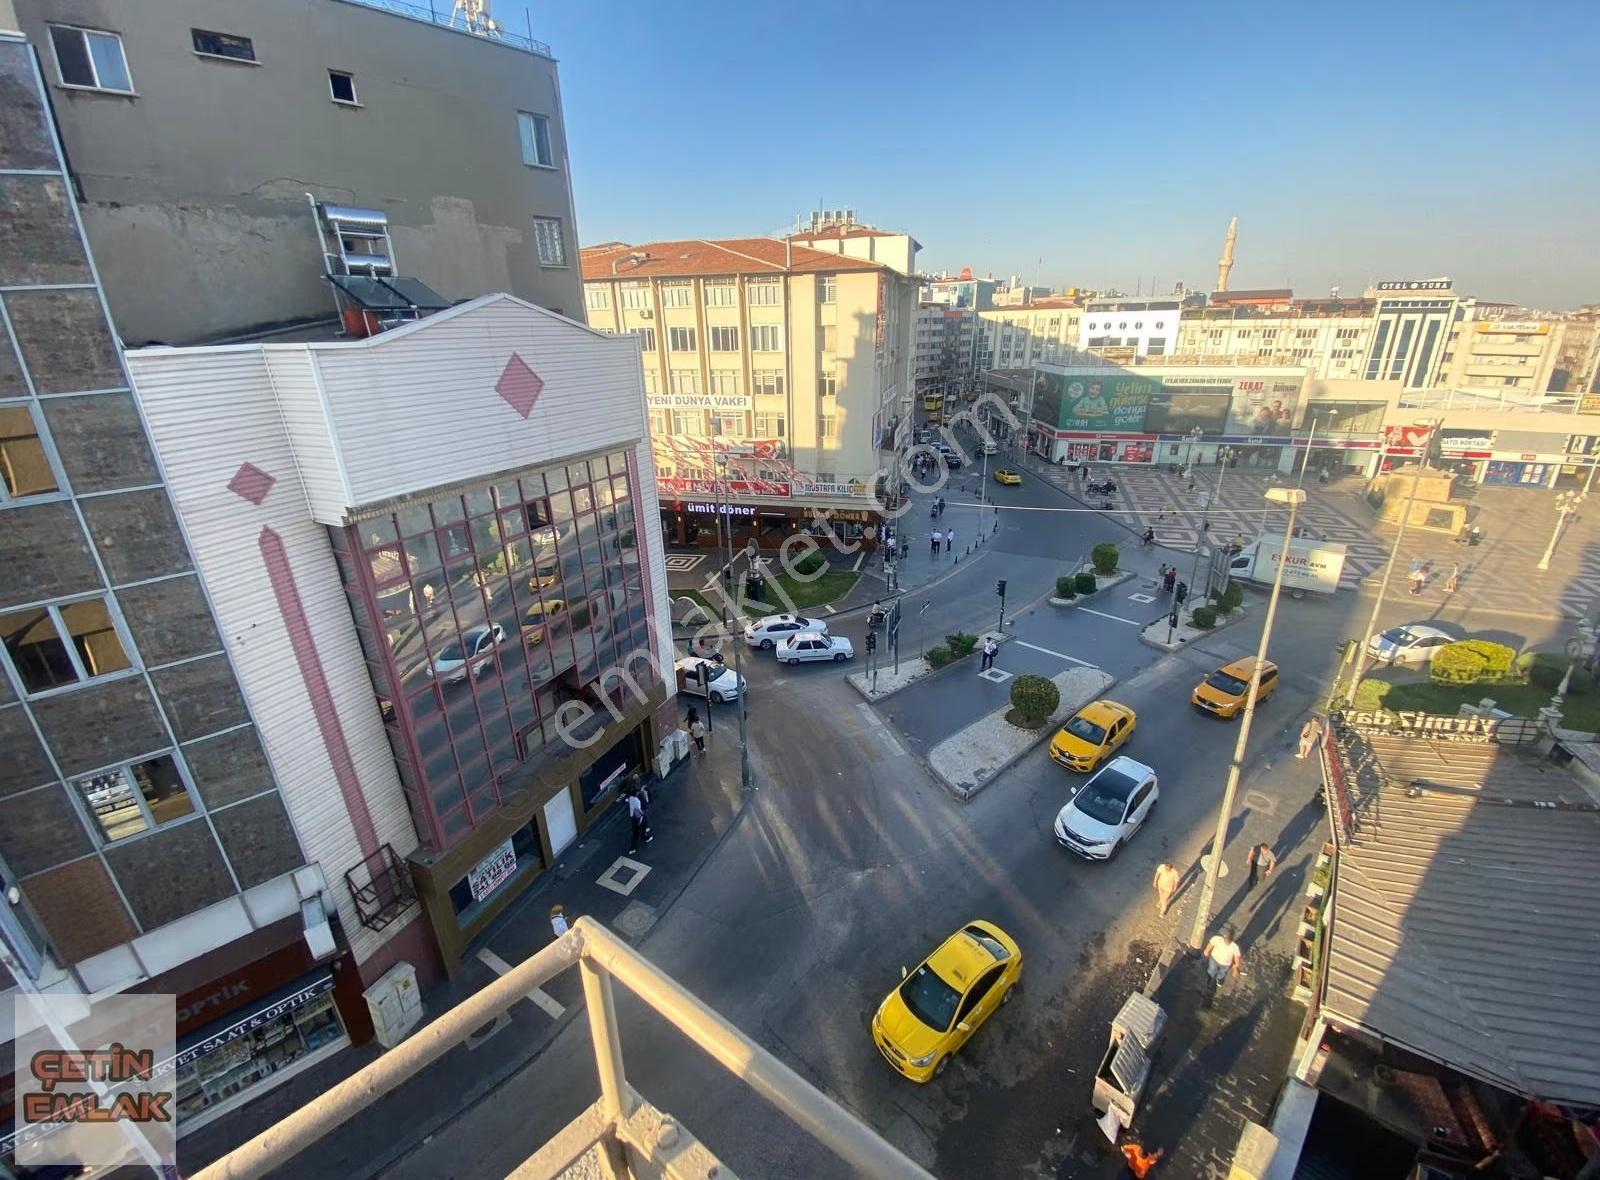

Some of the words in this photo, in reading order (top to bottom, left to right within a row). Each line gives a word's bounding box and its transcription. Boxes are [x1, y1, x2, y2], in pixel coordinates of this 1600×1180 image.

[1381, 282, 1407, 290] OTEL
[1422, 281, 1448, 290] TUNA
[1237, 381, 1265, 391] ZEKAT
[714, 397, 747, 407] VAKFI
[804, 484, 835, 493] MUSTAFA
[687, 502, 716, 514] ümit
[719, 503, 756, 515] döner
[1309, 561, 1327, 569] AVM
[176, 979, 250, 1023] OPTİK
[202, 1022, 249, 1053] SAAT
[249, 1017, 263, 1029] &
[265, 987, 318, 1020] OPTİK
